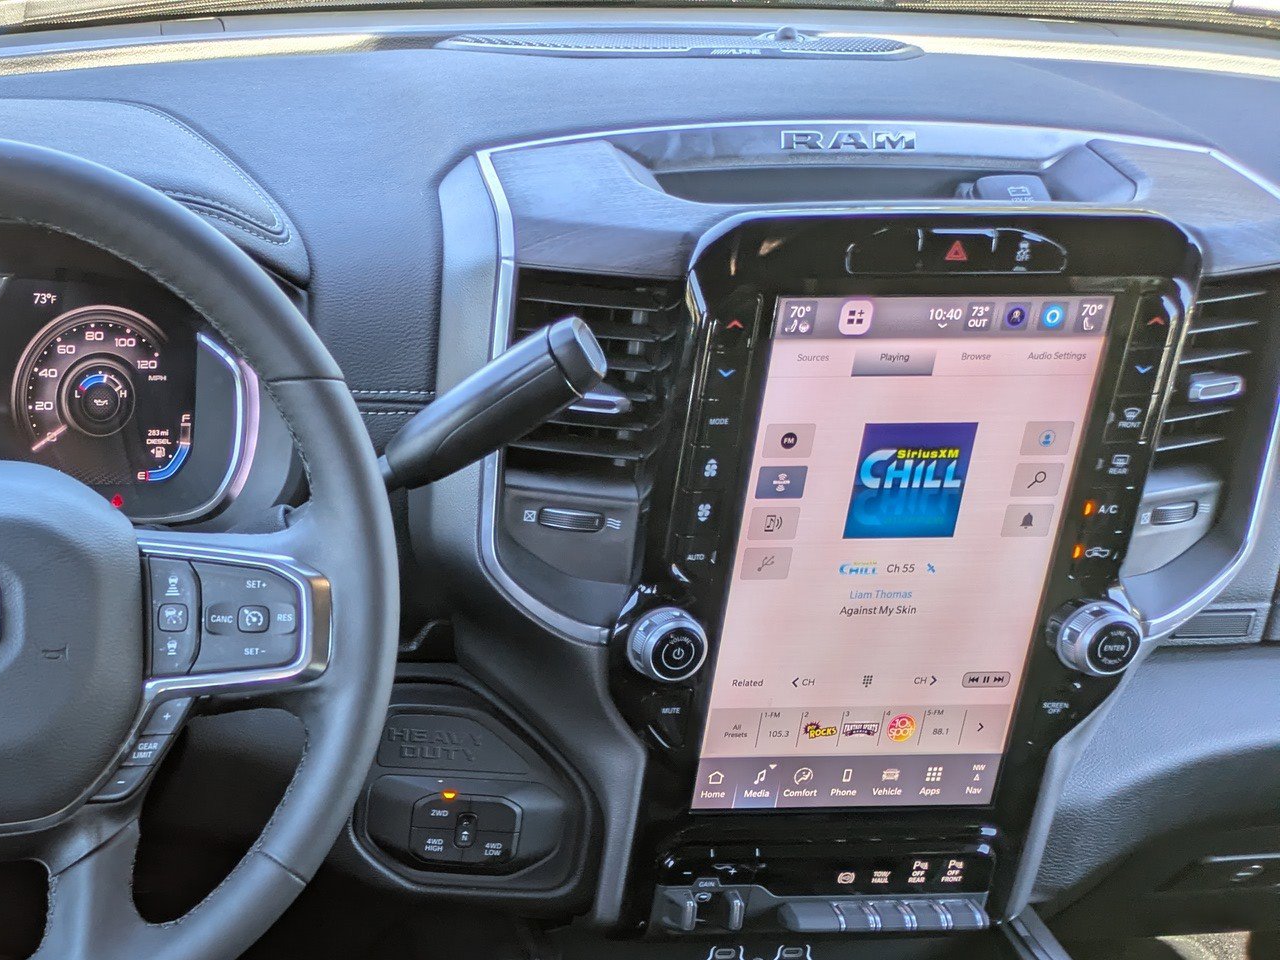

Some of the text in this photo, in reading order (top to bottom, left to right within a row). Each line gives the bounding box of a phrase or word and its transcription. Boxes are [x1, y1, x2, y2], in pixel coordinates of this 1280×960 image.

[780, 130, 917, 150] RAM
[33, 293, 57, 304] 73°F
[790, 306, 811, 319] 70°
[929, 308, 962, 321] 10:40
[971, 306, 990, 317] 73°
[1081, 304, 1103, 317] 70°
[968, 319, 988, 328] OUT
[85, 332, 104, 341] 80
[114, 338, 136, 347] 100
[57, 345, 75, 354] 60
[797, 354, 830, 362] Sources
[880, 353, 910, 364] Playing
[961, 352, 991, 361] Browse
[1028, 351, 1086, 362] Audio Settings
[137, 360, 157, 369] 120
[38, 368, 57, 378] 40
[74, 390, 81, 398] L
[120, 390, 127, 398] H
[35, 401, 53, 410] 20
[181, 414, 191, 422] F
[1117, 421, 1142, 429] FRONT
[147, 429, 169, 437] 283 mi
[896, 449, 960, 460] SiriusXM
[860, 449, 962, 489] CHILL
[137, 471, 146, 480] E
[1098, 504, 1119, 514] A/C
[687, 553, 705, 561] AUTO
[886, 563, 916, 573] Ch 55
[849, 589, 913, 599] Liam Thomas
[839, 605, 917, 617] Against My Skin
[210, 615, 234, 624] CANC
[277, 613, 293, 622] RES
[669, 635, 692, 645] VOLUME
[1103, 644, 1125, 652] ENTER
[731, 678, 764, 687] Related
[801, 678, 815, 686] CH
[914, 676, 927, 685] CH
[387, 728, 482, 746] HEAVY
[768, 730, 790, 738] 105.3
[809, 727, 837, 739] ROCKS
[138, 742, 158, 750] GEAR
[132, 751, 153, 759] LIMIT
[401, 744, 475, 761] DUTY
[700, 790, 726, 799] Home
[743, 789, 770, 798] Media
[783, 788, 818, 797] Comfort
[830, 788, 857, 797] Phone
[872, 787, 902, 796] Vehicle
[919, 786, 941, 797] Apps
[965, 786, 982, 795] Nav
[431, 809, 449, 817] 2WD
[485, 842, 502, 850] 4WD
